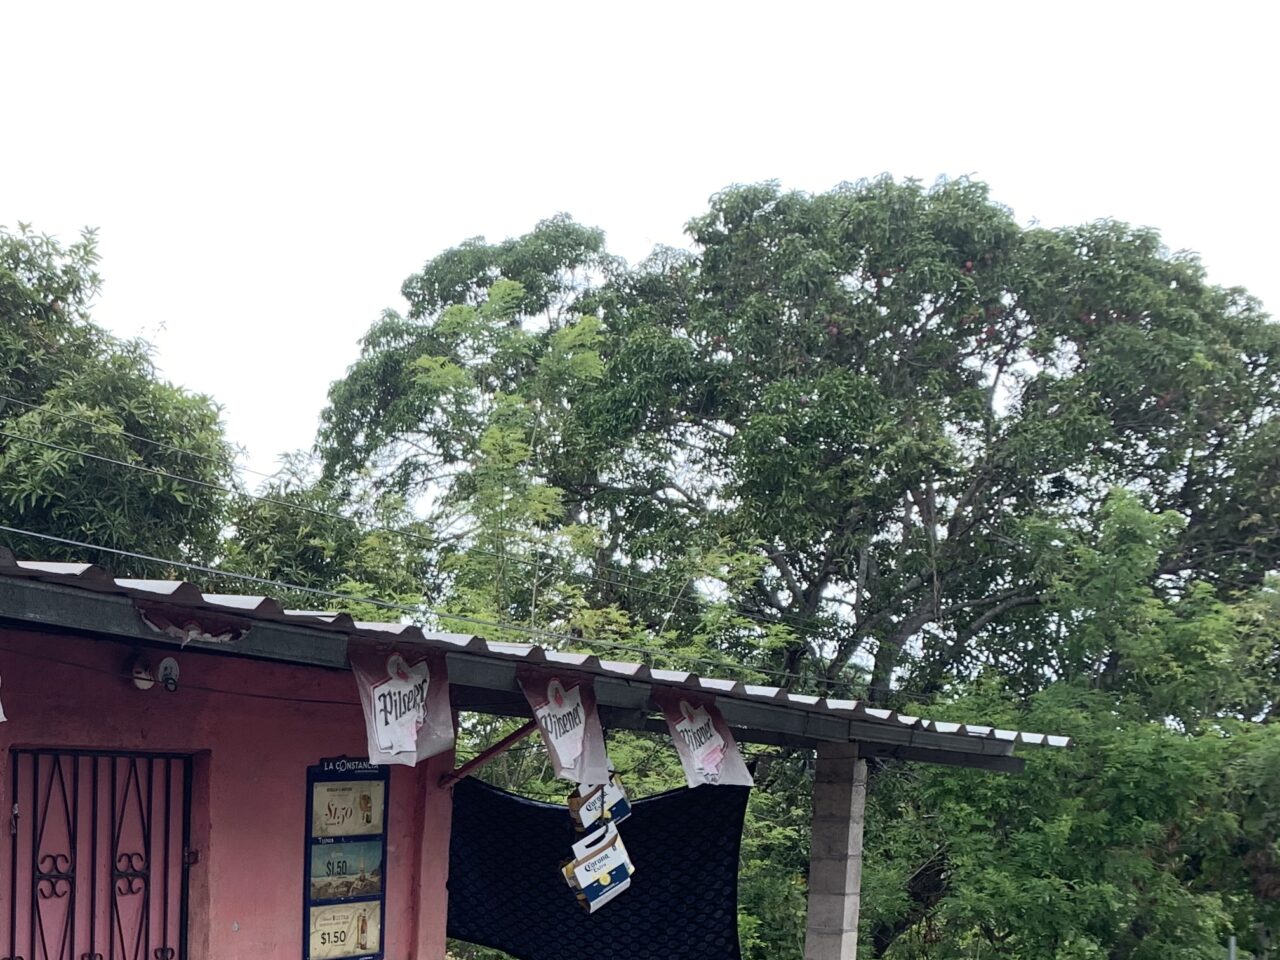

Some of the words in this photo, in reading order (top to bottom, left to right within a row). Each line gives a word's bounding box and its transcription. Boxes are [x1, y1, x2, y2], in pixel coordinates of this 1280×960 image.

[378, 678, 428, 727] Pilser
[324, 761, 334, 770] LA
[584, 853, 611, 872] Corona
[320, 930, 346, 946] $1.50
